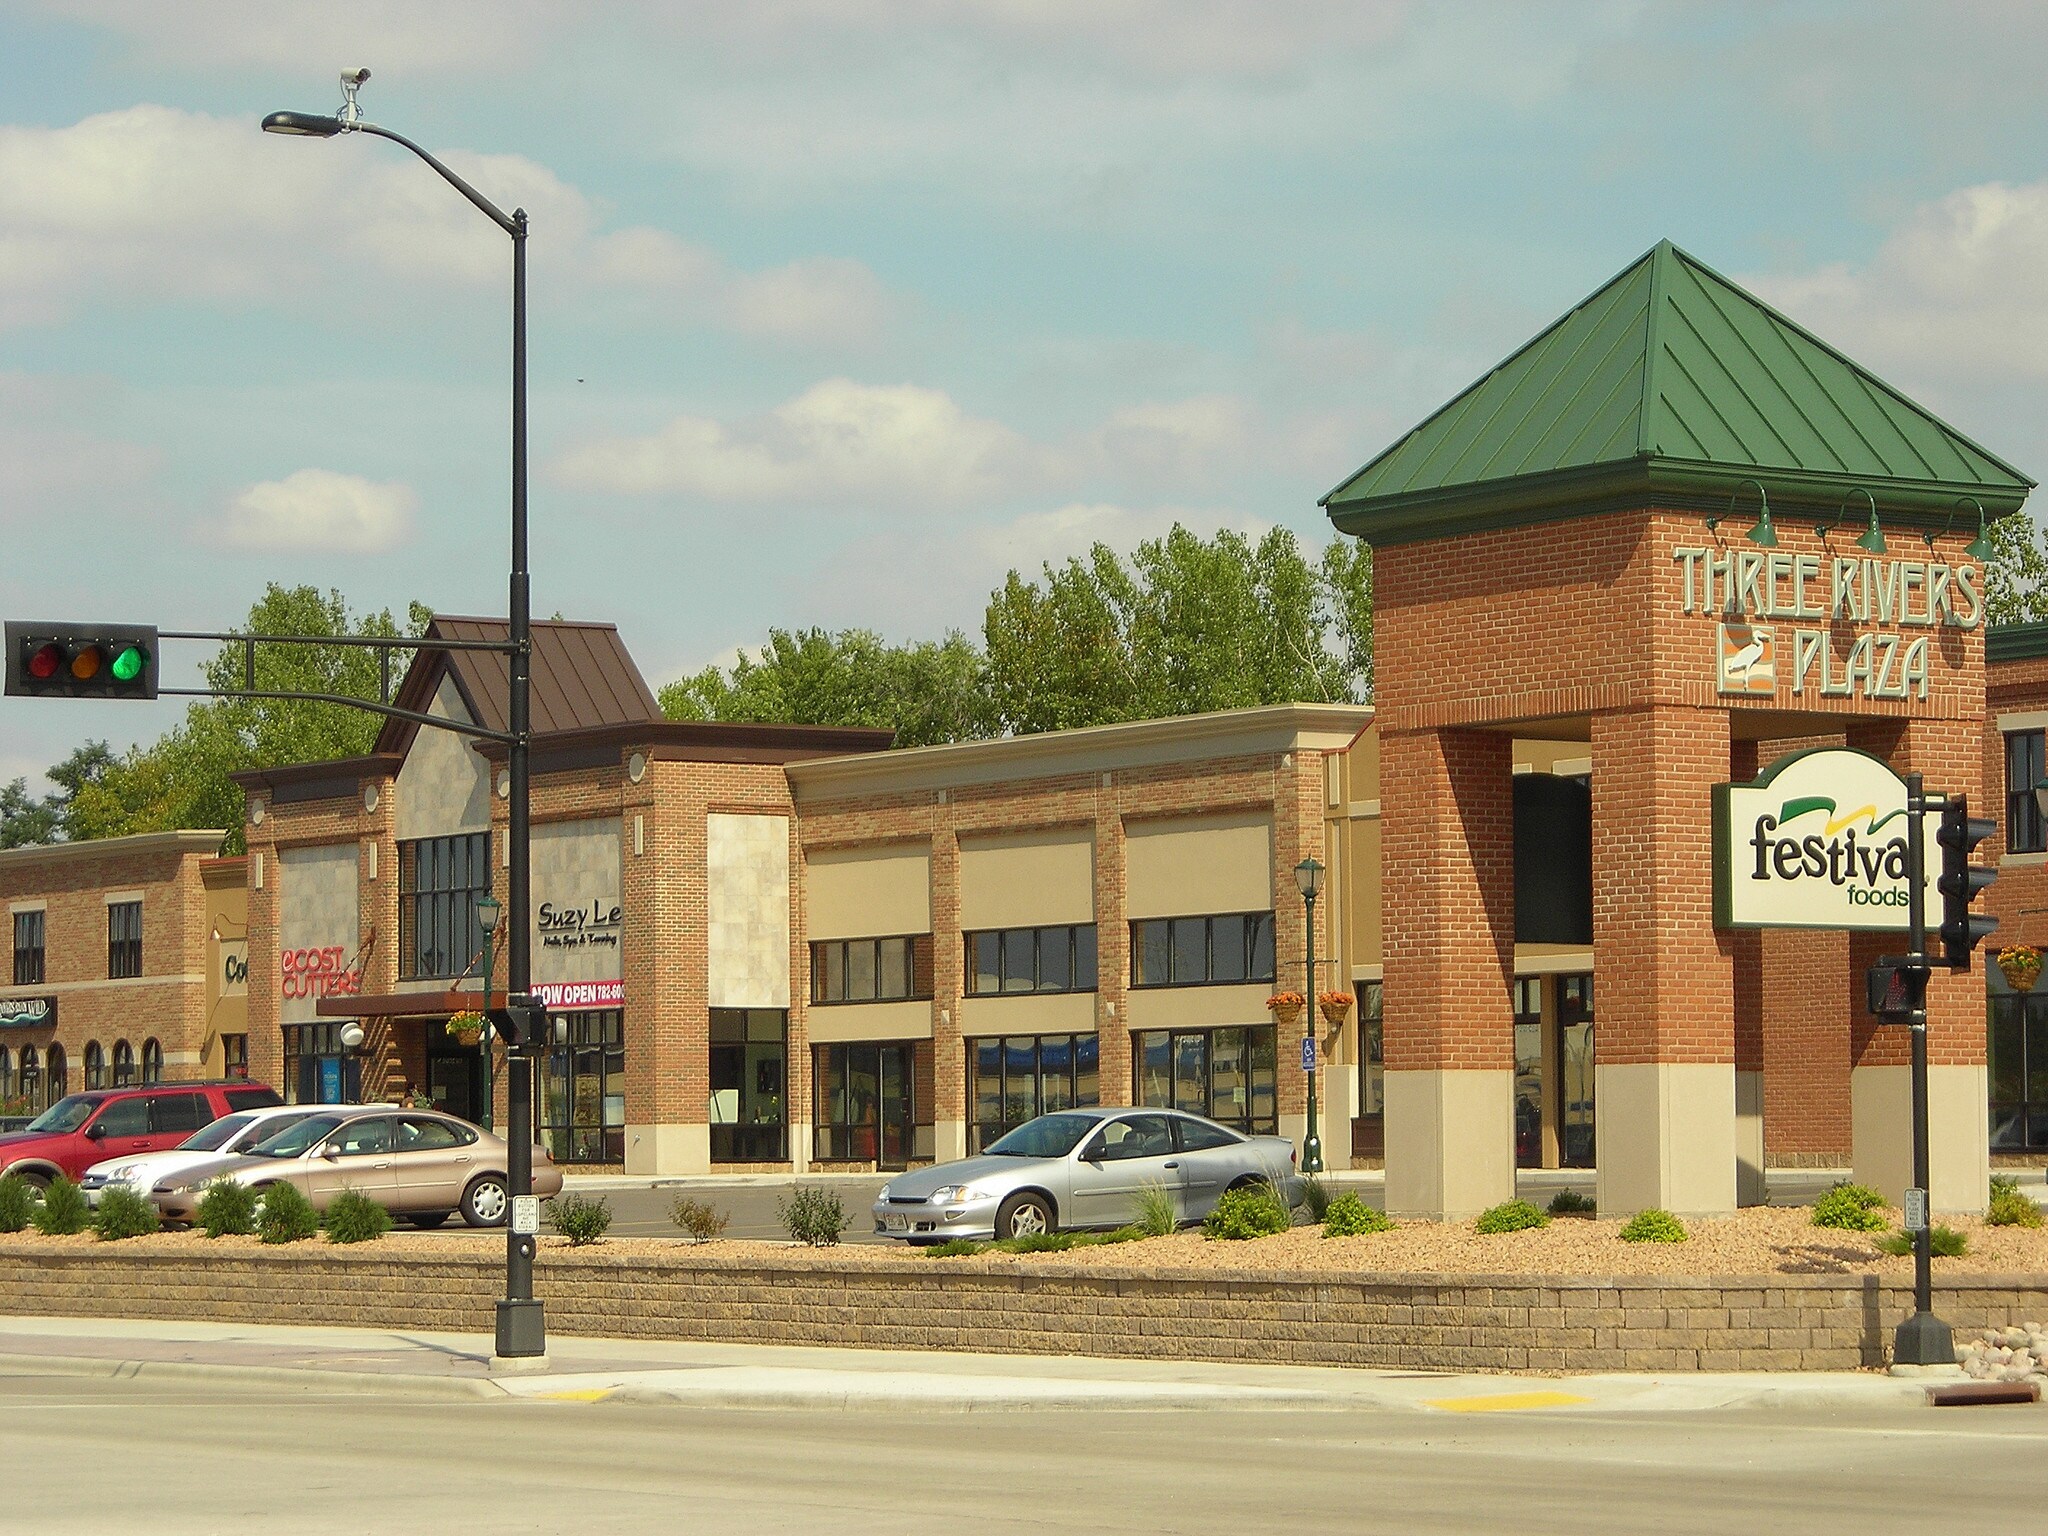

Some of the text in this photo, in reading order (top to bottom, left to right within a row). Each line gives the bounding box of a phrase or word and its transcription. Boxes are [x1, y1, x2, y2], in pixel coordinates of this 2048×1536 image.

[1673, 547, 1984, 630] THREE RIVERS
[1792, 629, 1928, 699] PLAZA
[1750, 814, 1912, 886] festiva
[1847, 884, 1910, 907] foods
[538, 899, 622, 931] Suzy Le
[282, 970, 362, 999] CUTTERS
[564, 984, 597, 1004] OPEN
